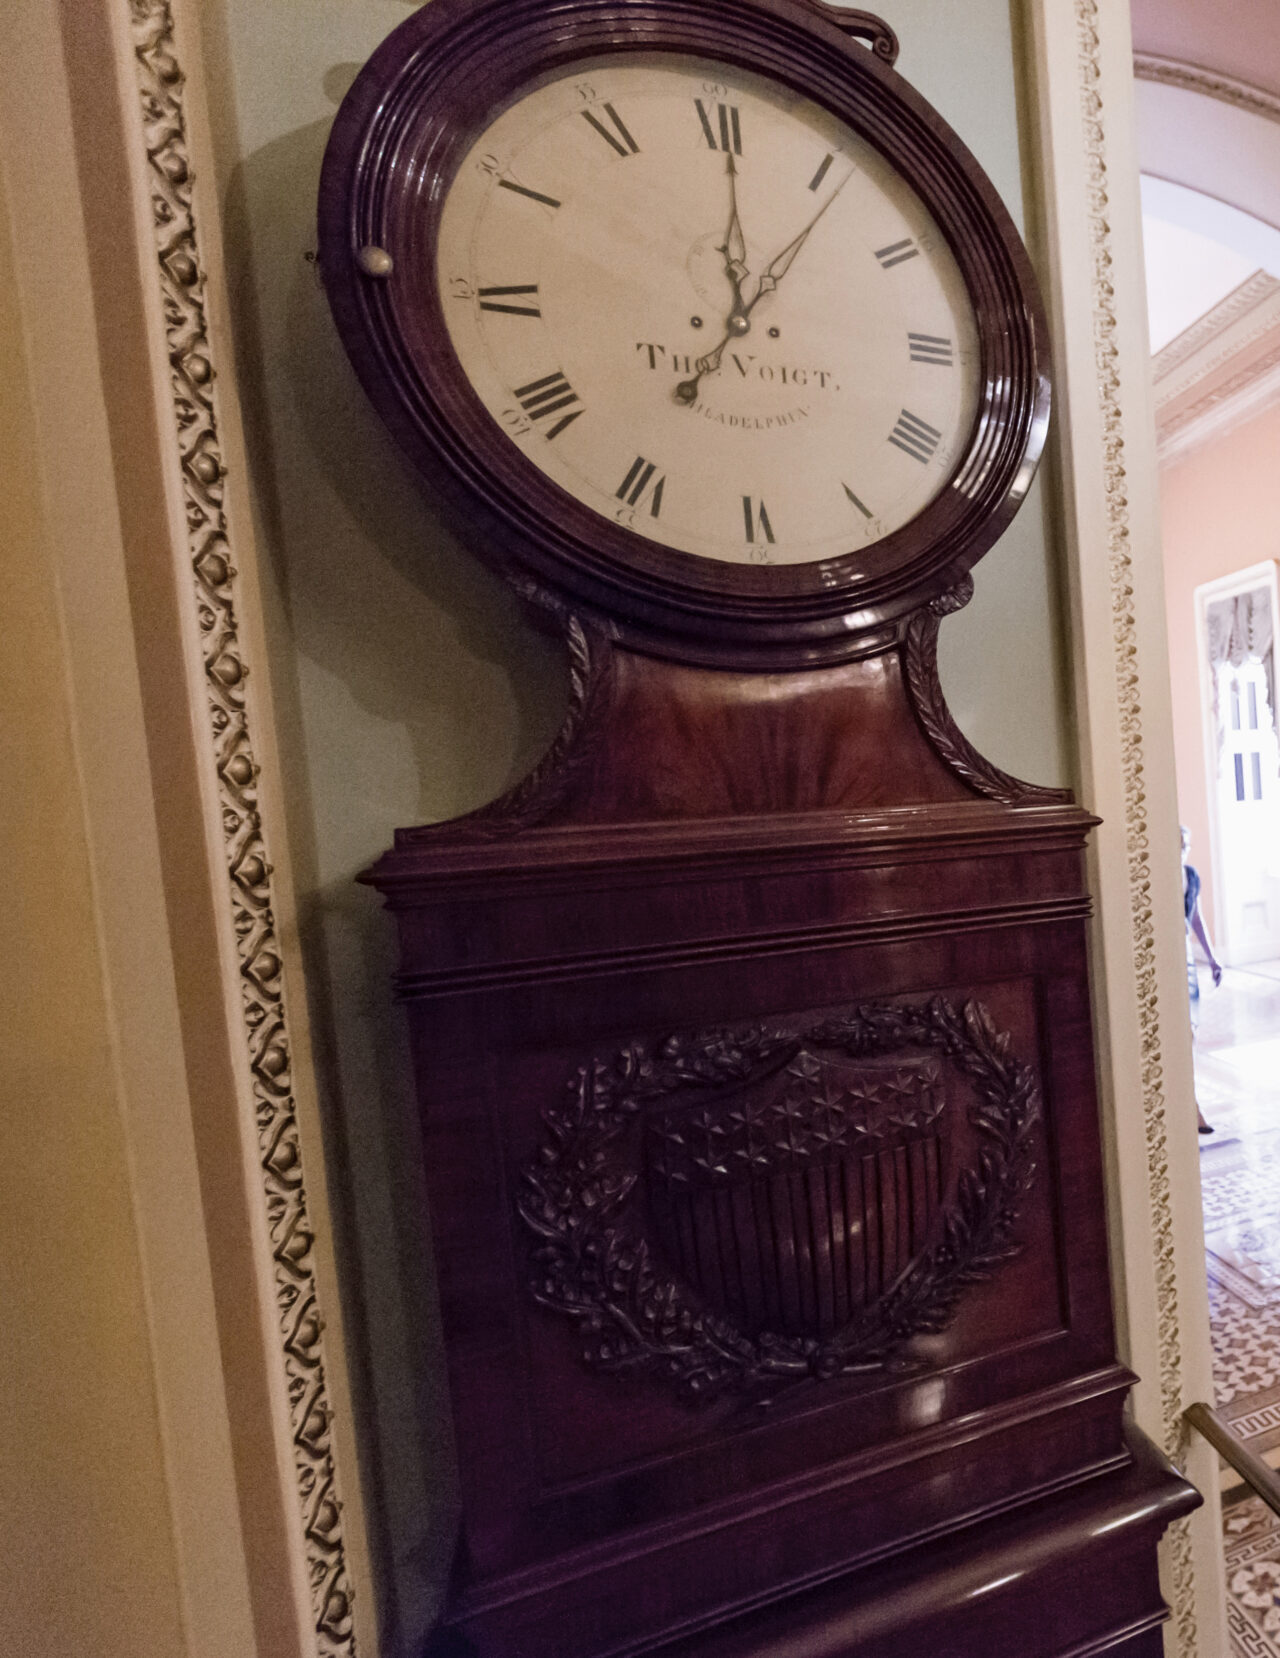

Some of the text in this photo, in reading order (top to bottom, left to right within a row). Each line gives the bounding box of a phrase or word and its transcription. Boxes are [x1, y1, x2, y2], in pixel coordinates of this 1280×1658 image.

[693, 98, 743, 156] XII
[873, 237, 921, 270] II
[907, 332, 953, 367] III
[512, 370, 587, 441] VIII
[887, 408, 942, 465] IIII
[614, 456, 667, 519] VII
[741, 495, 776, 544] VI
